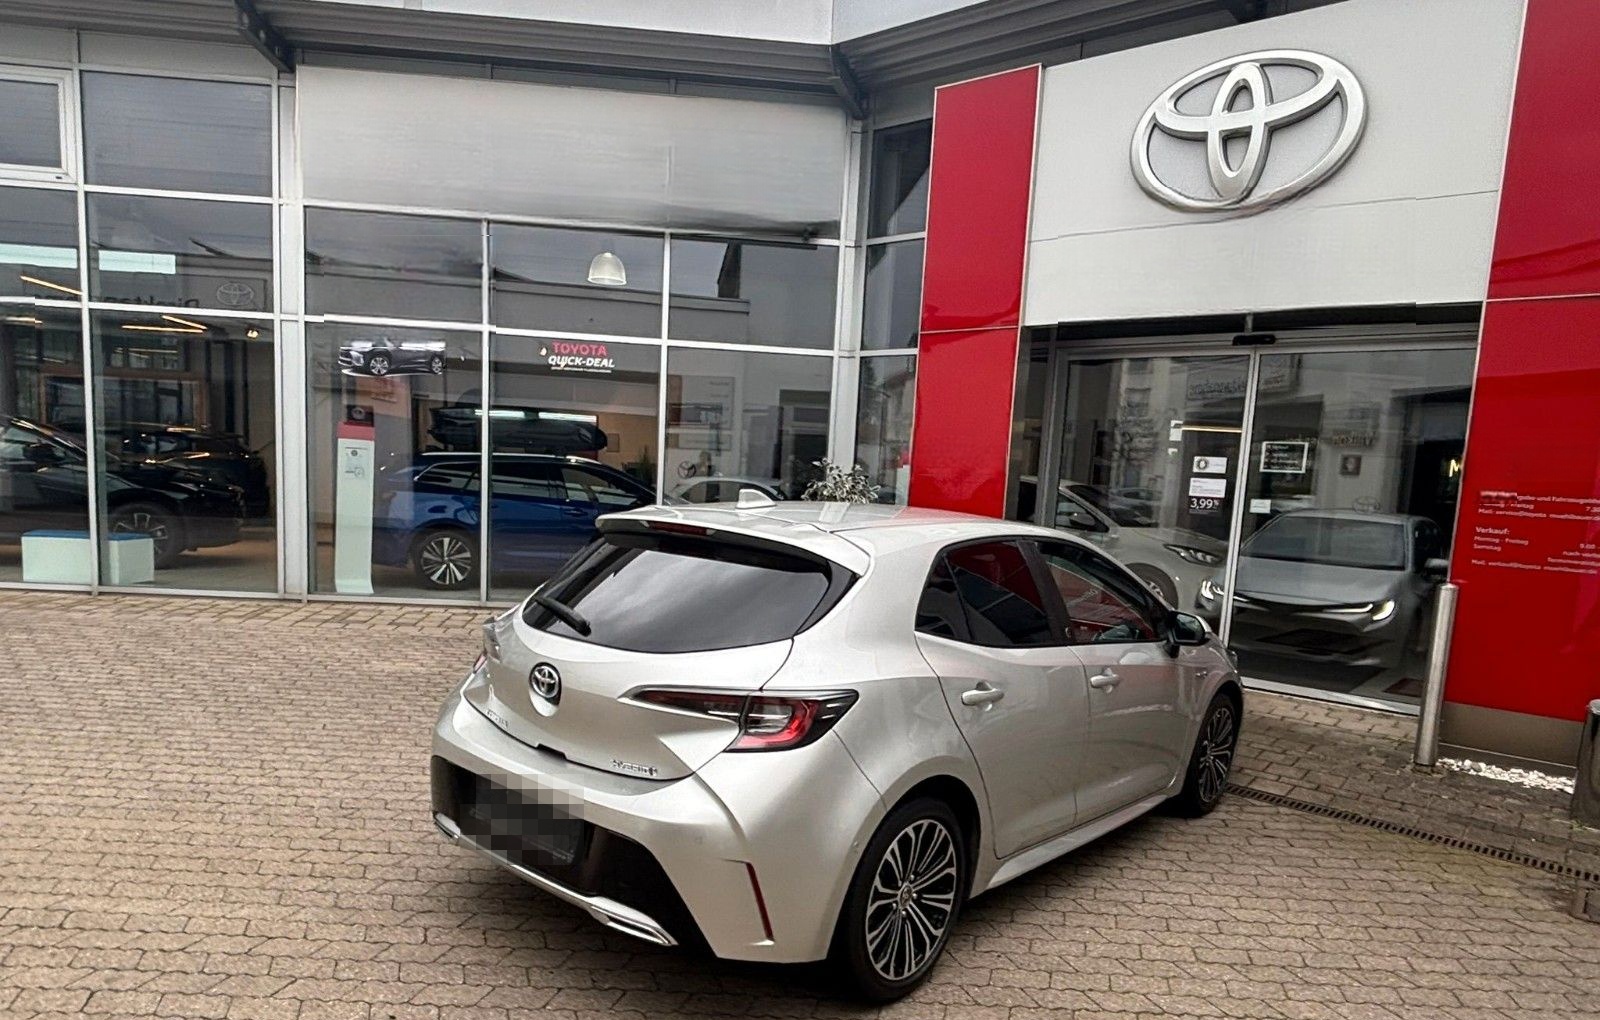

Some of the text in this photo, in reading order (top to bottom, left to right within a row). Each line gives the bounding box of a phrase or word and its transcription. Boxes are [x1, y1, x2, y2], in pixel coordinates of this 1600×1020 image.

[552, 342, 607, 357] TOYOTA
[548, 356, 615, 368] QUICK-DEAL
[1476, 526, 1510, 535] Verkauf:
[1474, 536, 1500, 544] Montag
[1505, 538, 1529, 546] Freitag
[1473, 543, 1501, 551] Samstag
